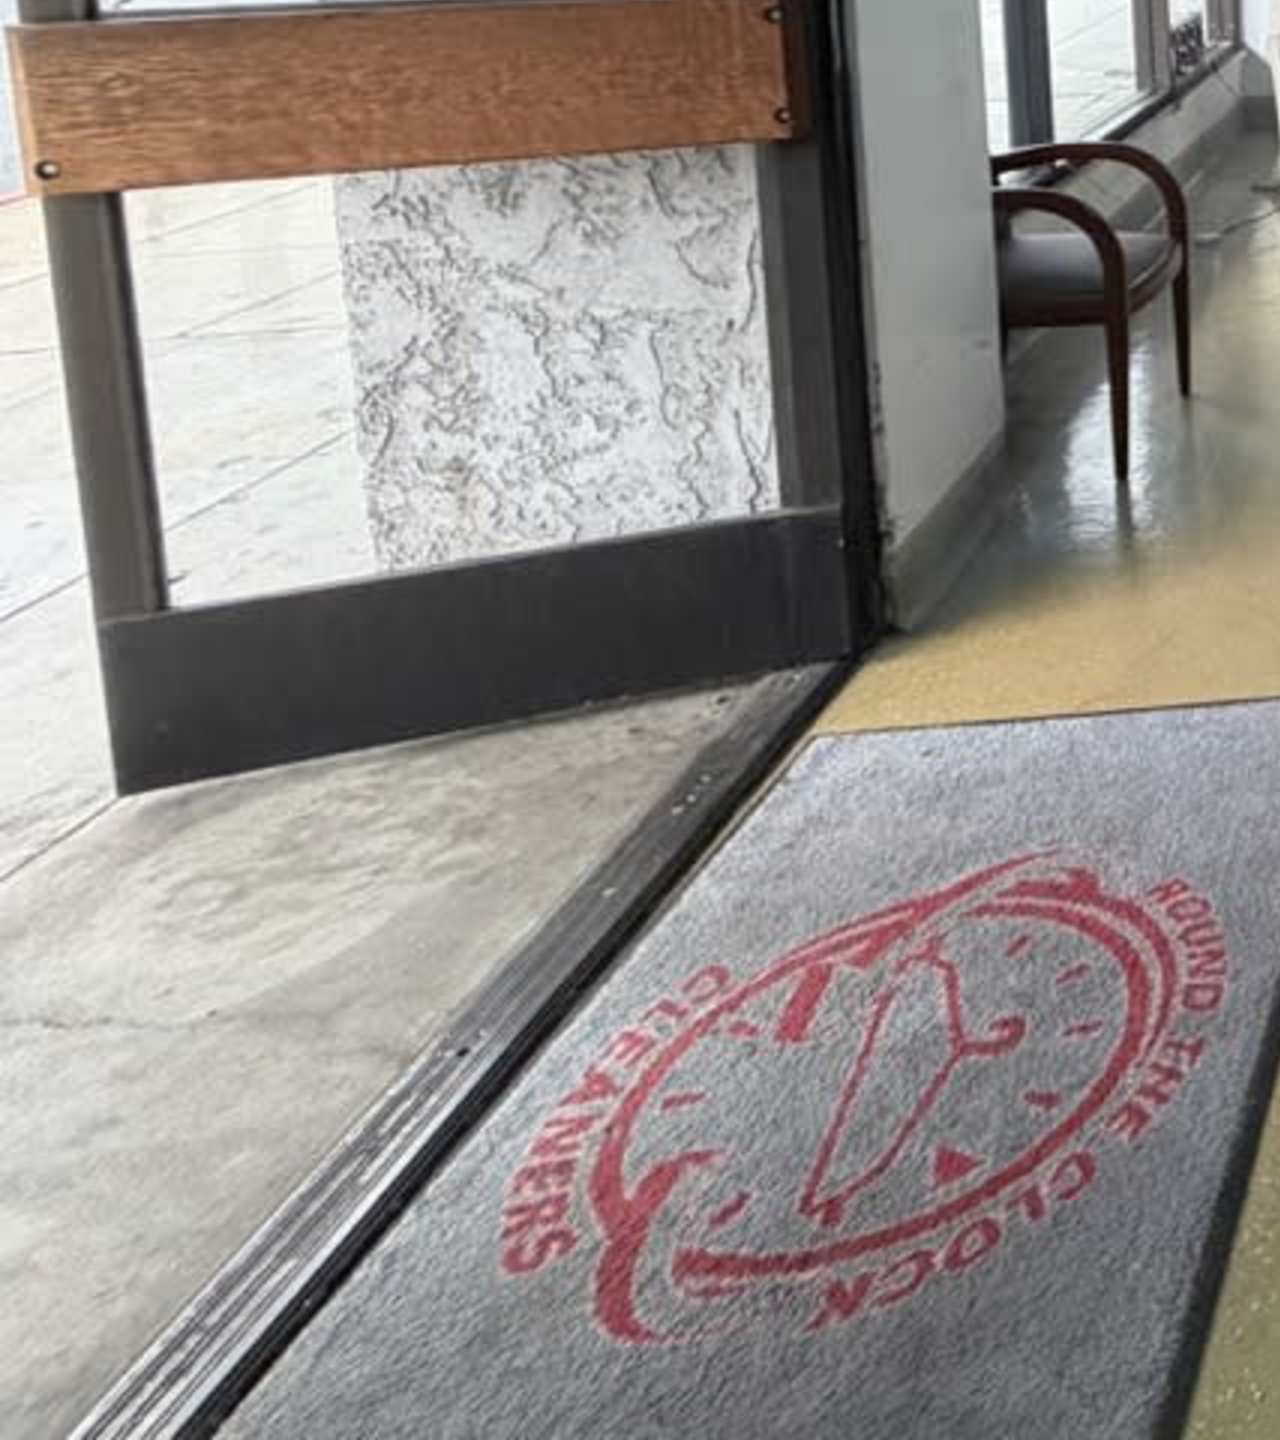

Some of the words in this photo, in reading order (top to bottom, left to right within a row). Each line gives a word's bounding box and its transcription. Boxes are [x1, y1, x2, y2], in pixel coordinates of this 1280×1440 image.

[1147, 877, 1228, 1016] ROUND
[500, 964, 731, 1275] CLEANERS
[1104, 1037, 1206, 1143] THE
[802, 1149, 1098, 1334] CLOCK
